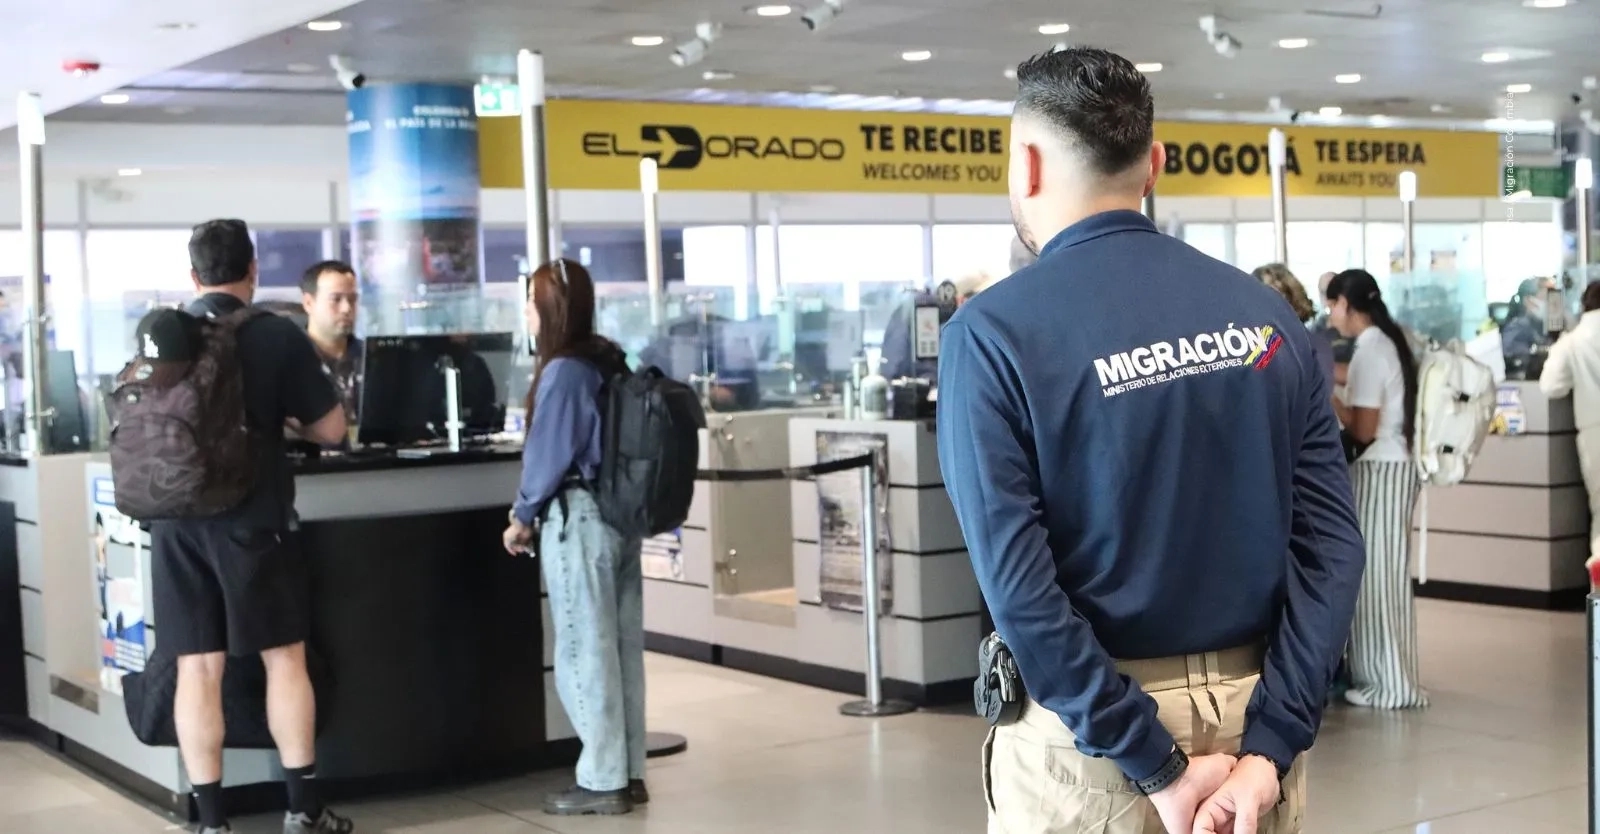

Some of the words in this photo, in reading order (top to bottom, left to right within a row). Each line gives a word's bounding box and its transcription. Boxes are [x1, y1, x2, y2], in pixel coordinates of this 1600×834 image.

[582, 132, 640, 156] EL
[860, 125, 894, 151] TE
[903, 126, 1003, 154] RECIBE
[1314, 140, 1339, 163] TE
[1346, 140, 1426, 165] ESPERA
[863, 163, 961, 181] WELCOMES
[967, 164, 1002, 182] YOU
[1316, 171, 1364, 188] AWAITS
[1094, 322, 1268, 386] MIGRACIÓN
[1103, 378, 1146, 397] MINISTERIO
[1146, 373, 1157, 385] DE
[1156, 365, 1200, 383] RELACIONES
[1200, 358, 1243, 374] EXTERIORES
